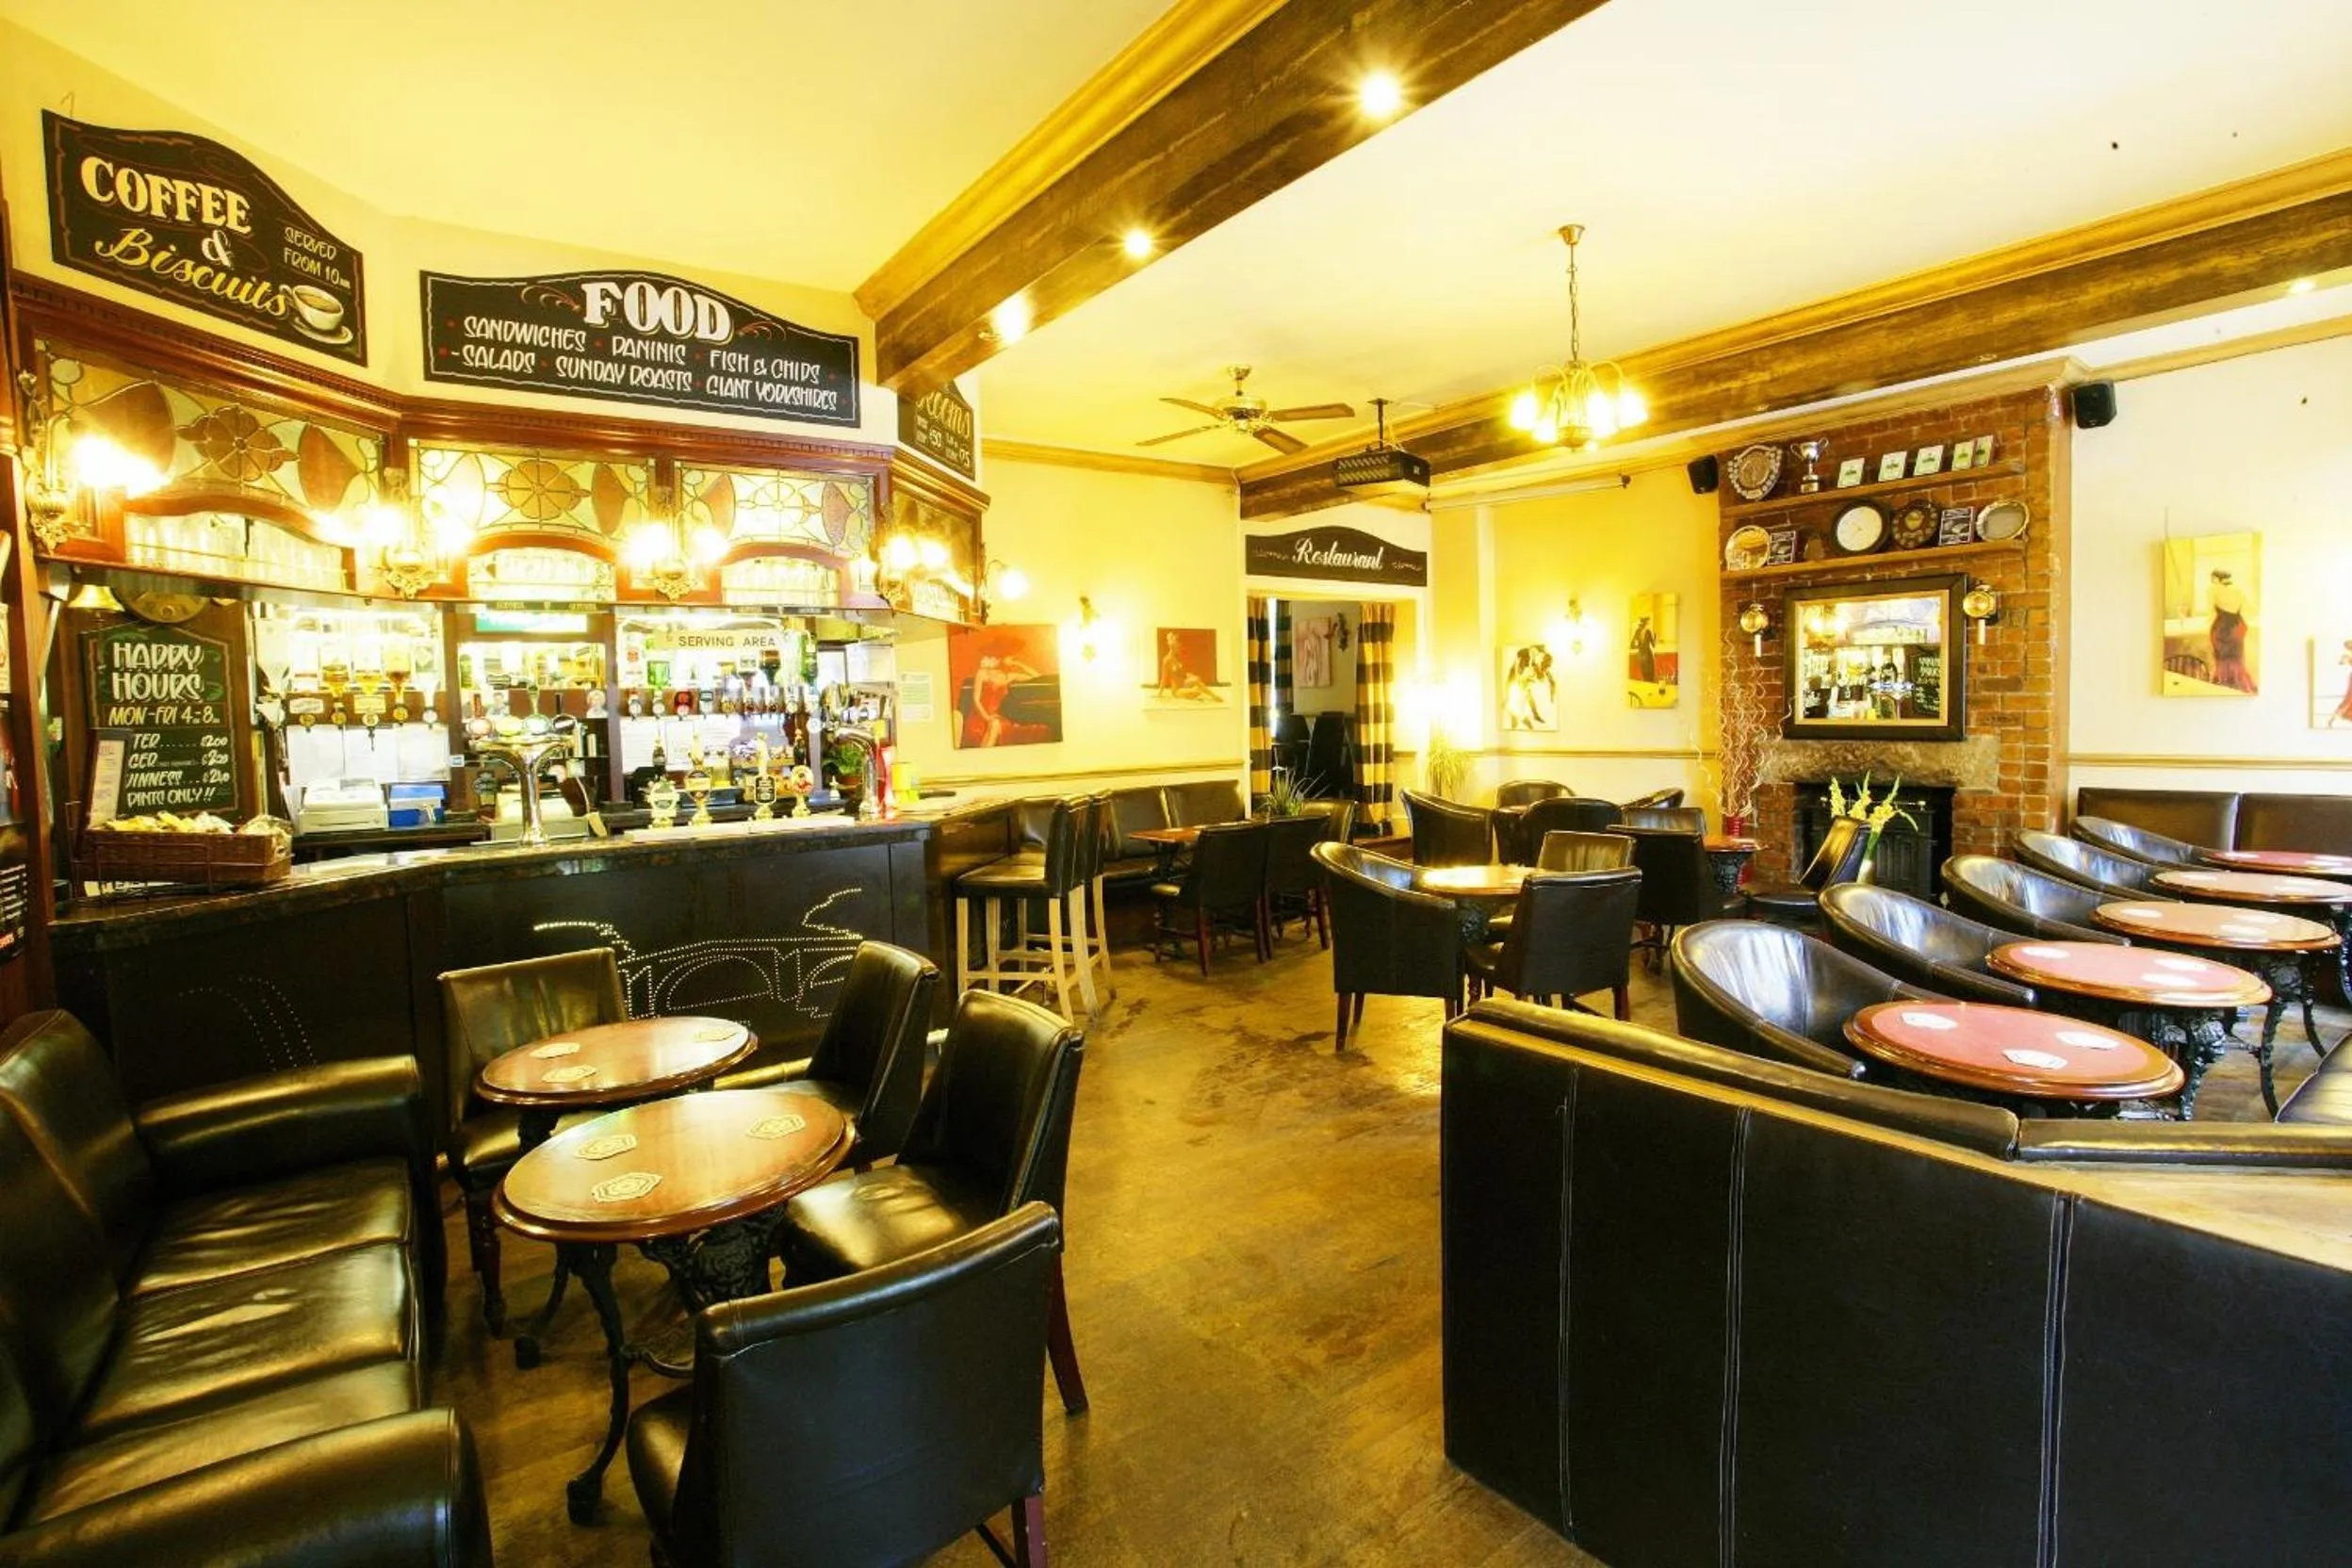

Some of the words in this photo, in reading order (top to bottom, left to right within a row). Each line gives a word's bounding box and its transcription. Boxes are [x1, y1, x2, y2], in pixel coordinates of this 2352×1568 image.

[80, 155, 252, 235] COFFEE
[201, 229, 234, 267] &
[285, 226, 336, 260] SERVED
[94, 227, 288, 318] Biscuits
[284, 247, 321, 276] FROM
[580, 281, 733, 344] FOOD
[464, 316, 587, 352] SANDWICHES
[612, 335, 686, 366] PANINIS
[710, 350, 750, 374] FISH
[754, 358, 768, 376] &
[771, 358, 821, 384] CHIPS
[462, 344, 535, 374] SALADS
[555, 355, 626, 384] SUNDAY
[629, 365, 693, 392] ROASTS
[707, 374, 753, 400] GIANT
[755, 381, 838, 412] YORKSHIRES
[1292, 537, 1383, 571] Restaurant
[113, 642, 204, 670] HAPPY
[678, 636, 734, 647] SERVING
[743, 636, 776, 646] AREA
[112, 672, 204, 702] HOURS
[127, 791, 165, 808] PINTS
